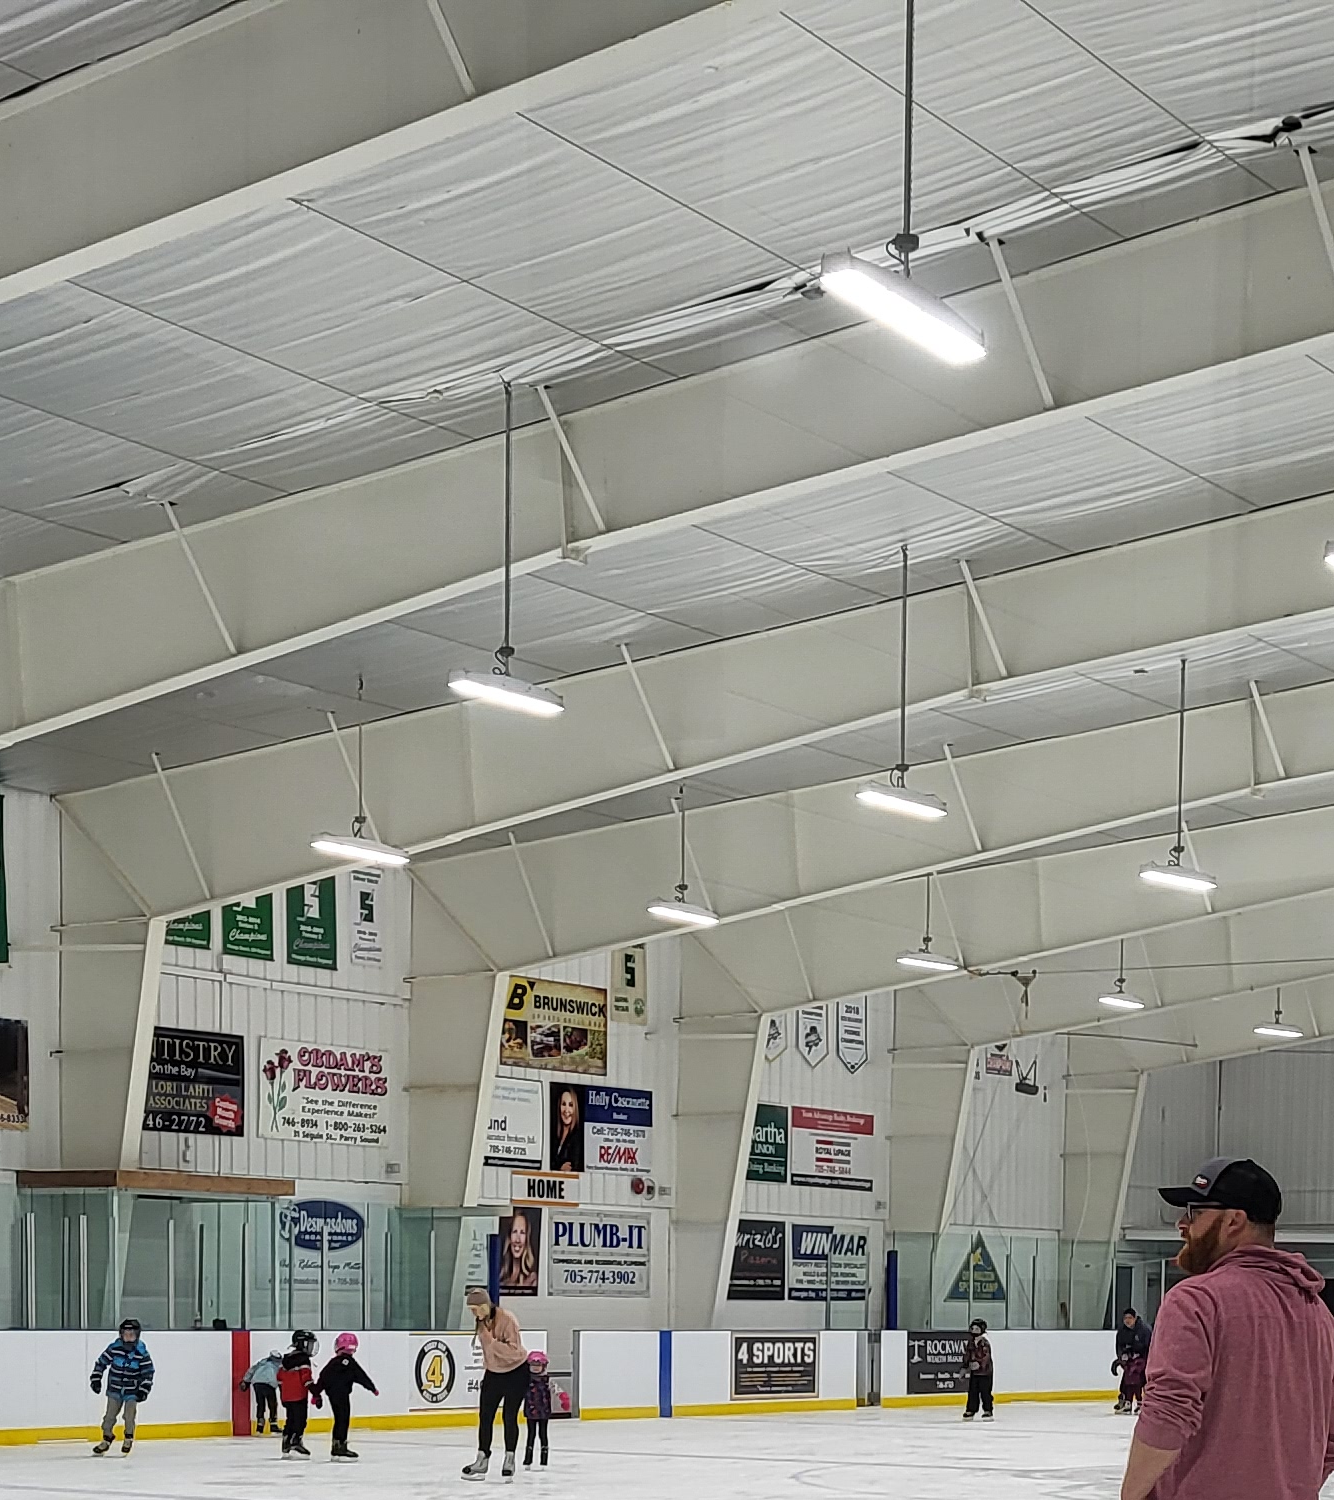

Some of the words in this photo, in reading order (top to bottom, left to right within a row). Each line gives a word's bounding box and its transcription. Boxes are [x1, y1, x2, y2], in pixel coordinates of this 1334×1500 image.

[533, 995, 607, 1018] BRUNSWICK
[151, 1062, 163, 1073] On
[165, 1064, 179, 1074] the
[181, 1065, 195, 1078] Bay
[298, 1047, 382, 1074] OBDAM'S
[152, 1081, 176, 1094] LORI
[182, 1083, 212, 1097] LAHTI
[292, 1068, 387, 1096] FLOWERS
[149, 1096, 207, 1111] ASSOCIATES
[599, 1145, 638, 1164] RE/MAX
[527, 1179, 564, 1199] HOME
[554, 1222, 646, 1249] PLUMB-IT
[800, 1231, 867, 1256] WINMAR
[564, 1270, 635, 1284] 705-774-3902
[738, 1342, 748, 1363] 4
[753, 1342, 814, 1363] SPORTS
[426, 1355, 444, 1388] 4
